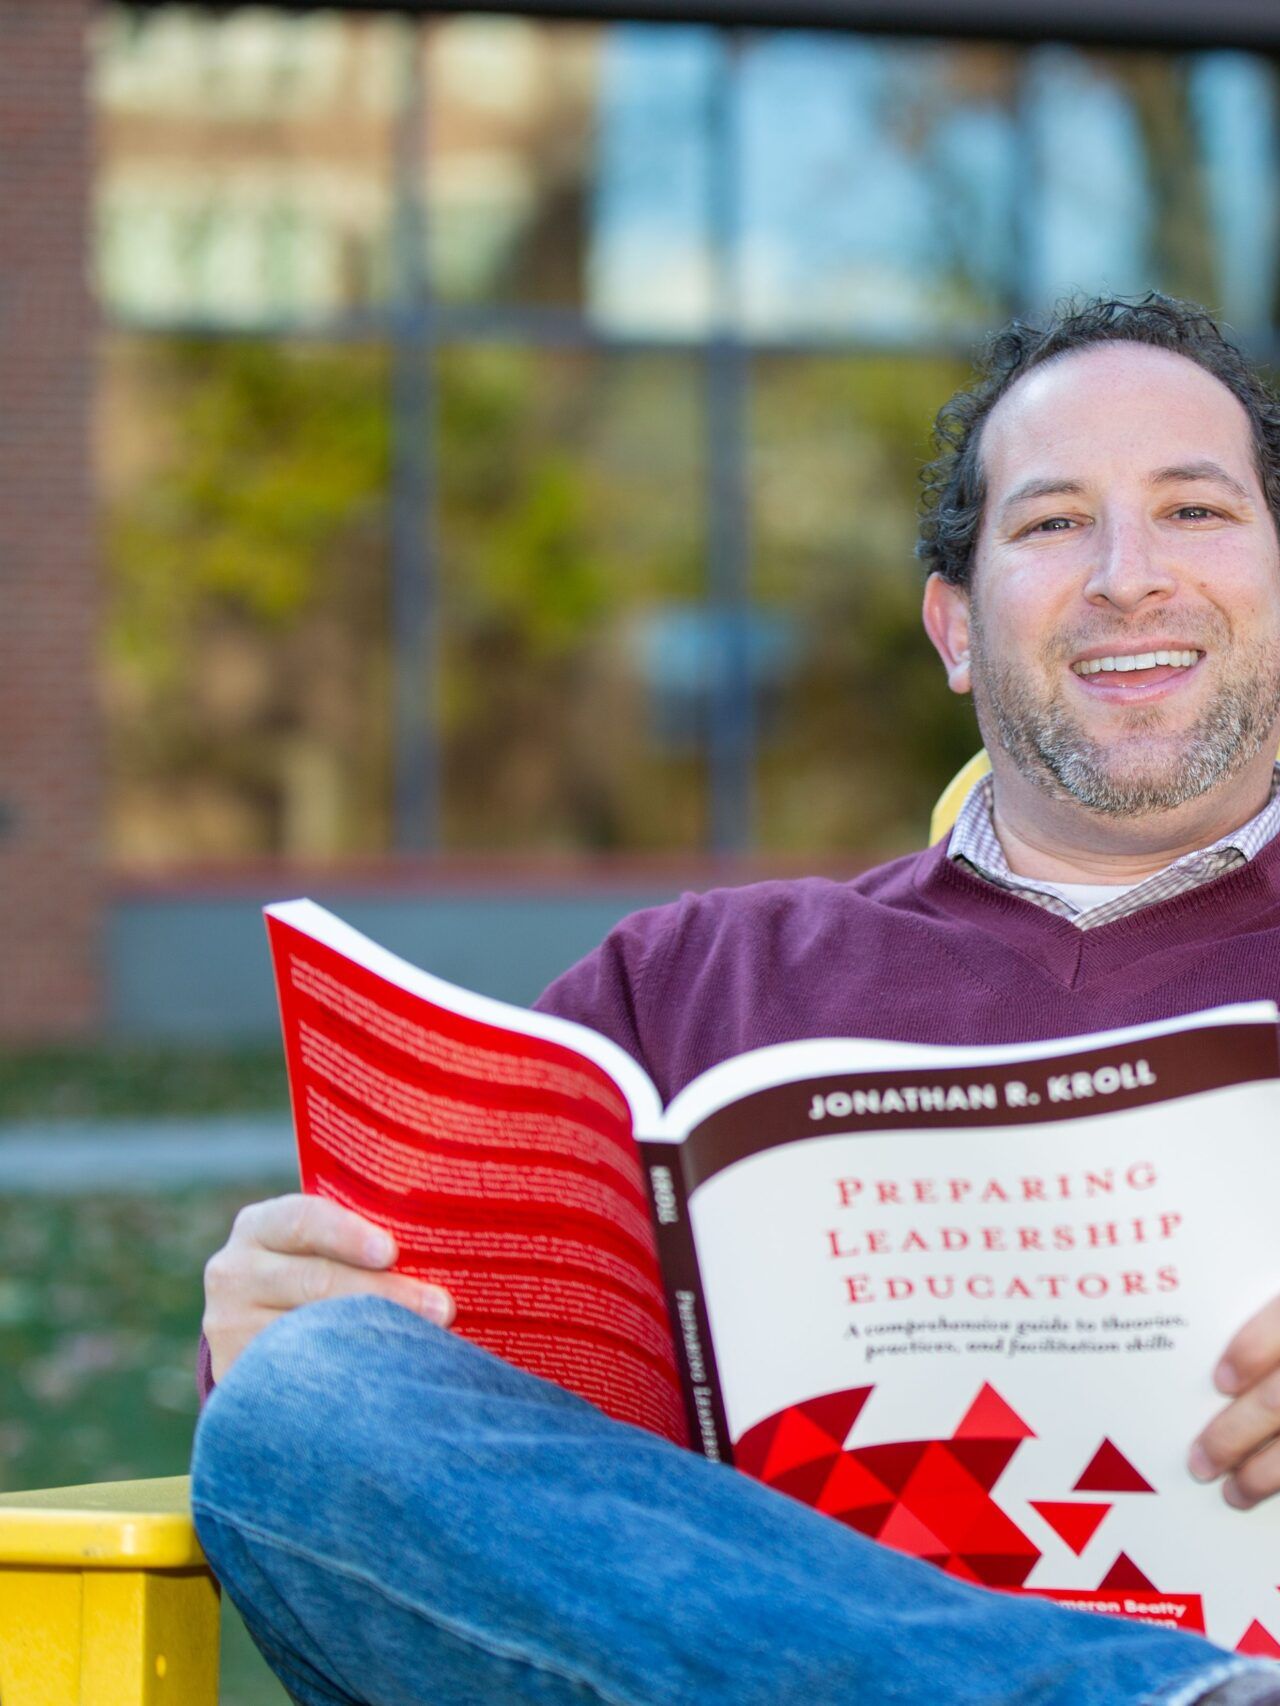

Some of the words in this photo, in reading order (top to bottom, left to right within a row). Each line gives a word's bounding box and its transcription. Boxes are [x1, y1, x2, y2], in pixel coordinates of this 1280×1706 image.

[808, 1083, 998, 1120] JONATHAN
[1004, 1081, 1041, 1108] R.
[1047, 1059, 1157, 1102] KROLL
[835, 1160, 1158, 1208] PREPARING
[826, 1211, 1182, 1258] LEADERSHIP
[844, 1265, 1180, 1304] EDUCATORS
[843, 1322, 859, 1340] A
[865, 1314, 1009, 1338] comprehensive
[1016, 1314, 1069, 1335] guide
[1075, 1318, 1096, 1332] to
[865, 1341, 960, 1362] practices,
[966, 1336, 1004, 1353] and
[1008, 1335, 1120, 1359] facilitation
[1125, 1332, 1176, 1352] skills
[693, 1386, 720, 1462] LEADERS
[1123, 1599, 1187, 1618] Beatty
